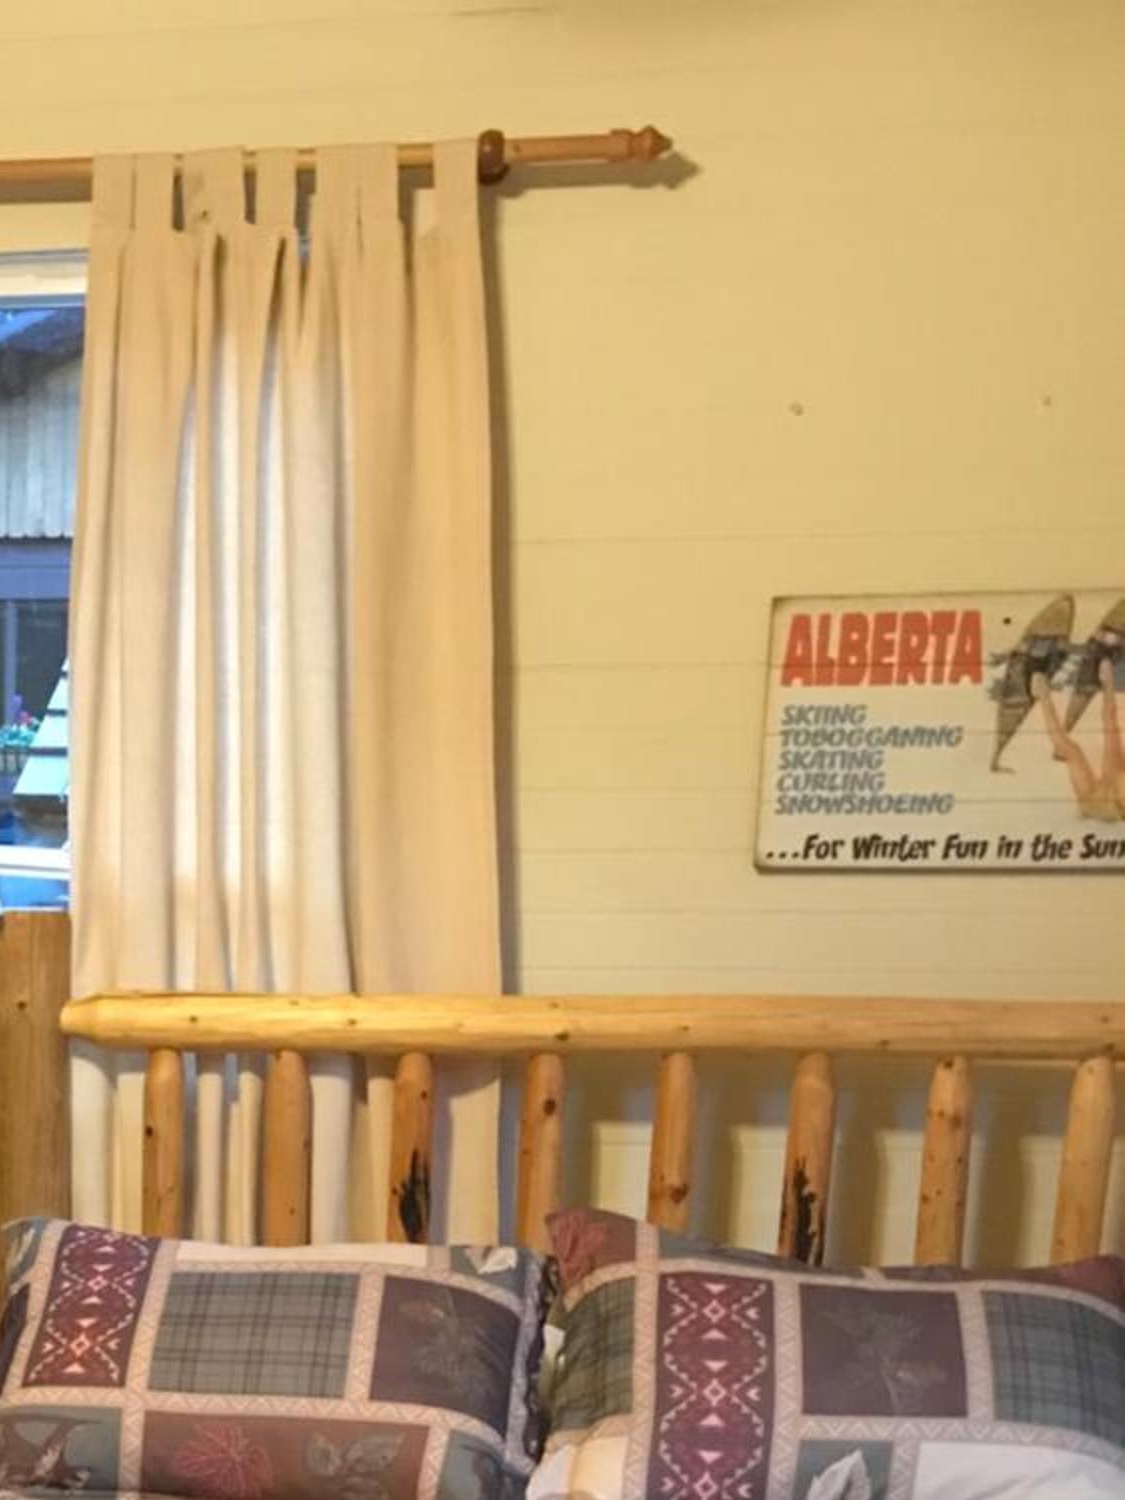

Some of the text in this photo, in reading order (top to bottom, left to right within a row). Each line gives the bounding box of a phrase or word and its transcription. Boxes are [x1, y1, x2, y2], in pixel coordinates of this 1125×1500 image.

[781, 610, 982, 687] ALBERTA
[781, 703, 868, 727] SKIING
[779, 725, 964, 748] TOBOGGANING
[778, 749, 884, 771] SKATING
[776, 771, 885, 792] CURLING
[775, 793, 955, 815] SNOWSHOEING
[851, 833, 937, 862] Winter
[941, 833, 988, 861] Fun
[996, 834, 1023, 859] in
[1032, 833, 1073, 861] the
[1080, 832, 1125, 860] Sun
